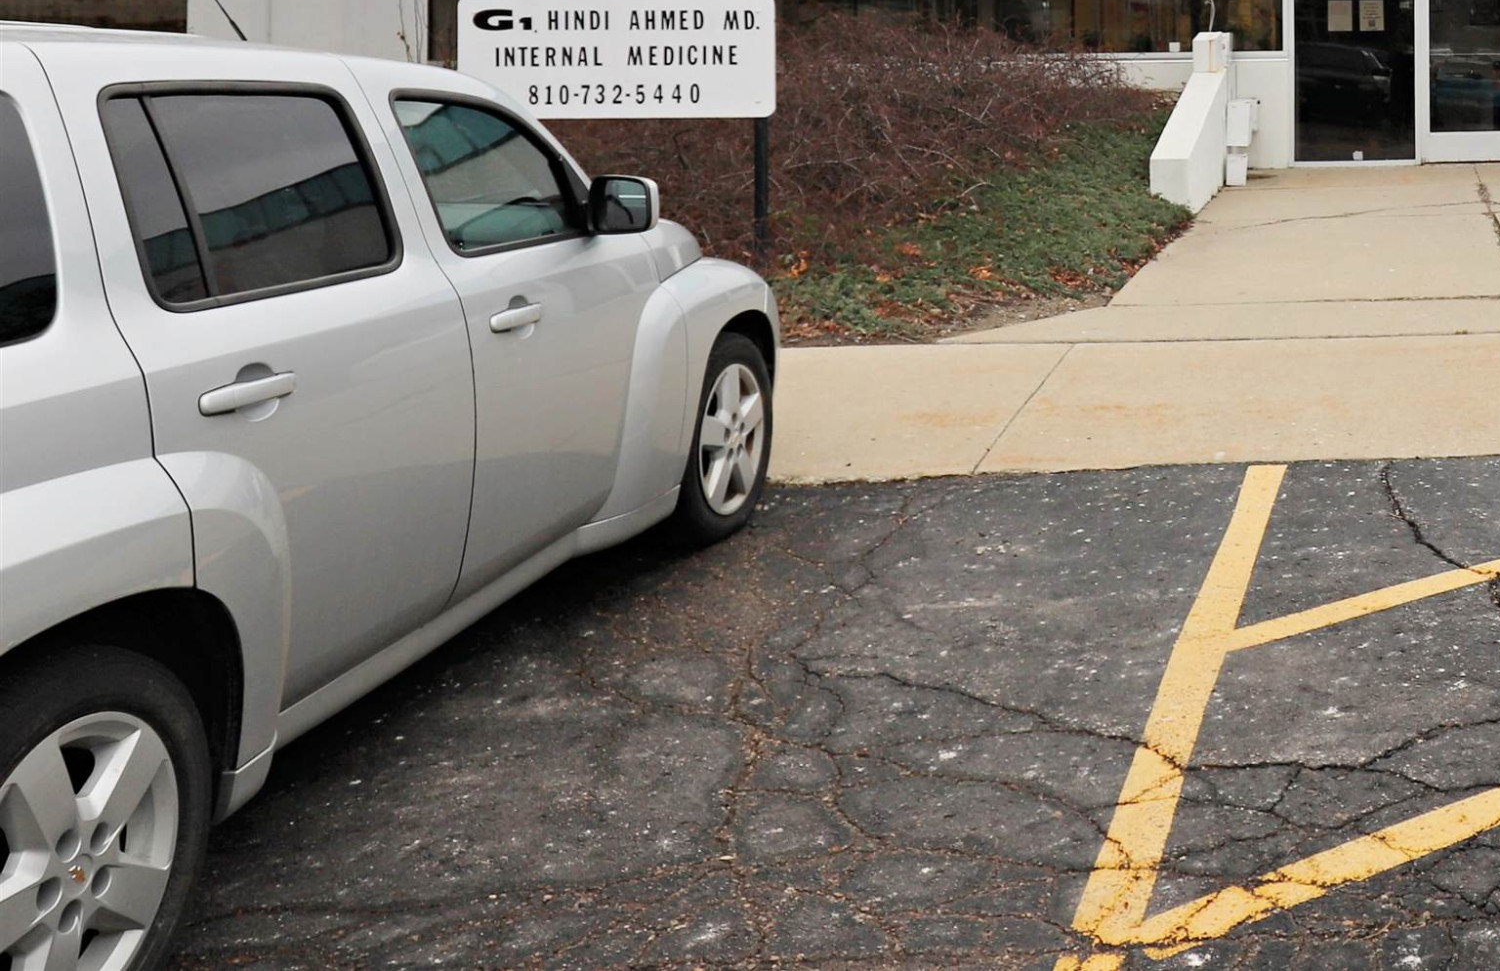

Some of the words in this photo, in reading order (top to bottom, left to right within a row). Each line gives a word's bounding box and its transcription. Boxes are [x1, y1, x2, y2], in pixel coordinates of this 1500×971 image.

[548, 10, 609, 31] HINDI
[629, 10, 705, 30] AHMED
[723, 10, 760, 30] MD.
[495, 47, 603, 67] INTERNAL
[627, 45, 738, 66] MEDICINE
[528, 84, 700, 105] 810-732-5440
